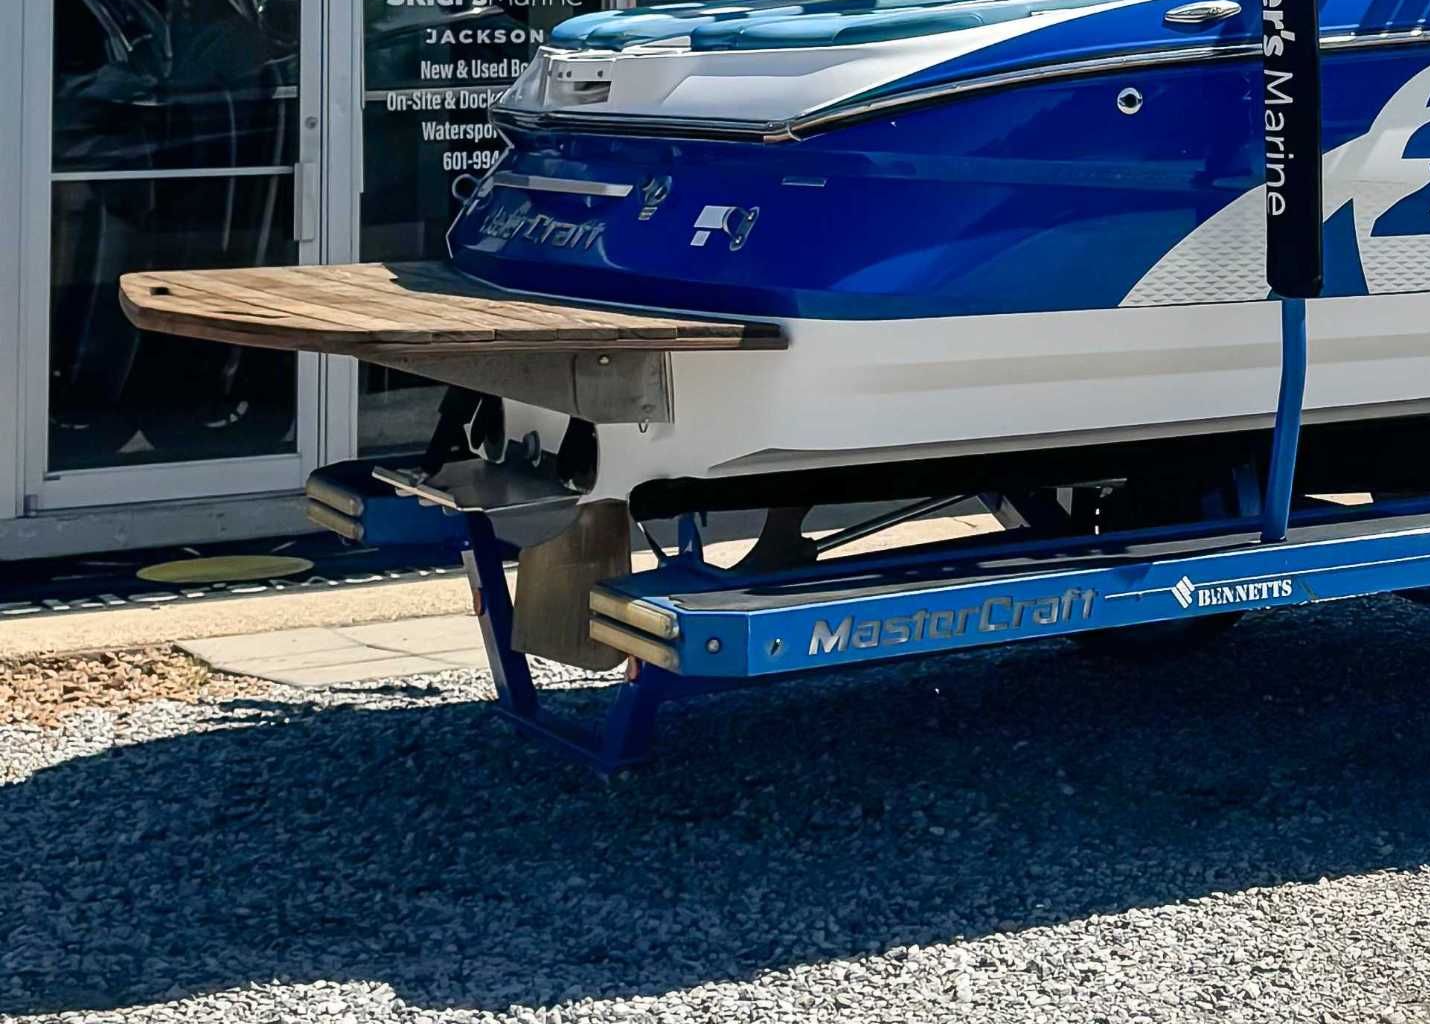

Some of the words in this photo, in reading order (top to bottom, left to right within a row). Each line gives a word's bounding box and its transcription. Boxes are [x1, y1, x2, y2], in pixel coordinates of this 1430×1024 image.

[426, 28, 544, 45] JACKSON
[420, 60, 454, 80] New
[456, 59, 469, 78] &
[471, 58, 507, 78] Used
[386, 91, 442, 111] On-Site
[444, 91, 456, 110] &
[1265, 70, 1295, 216] Marine
[1197, 578, 1293, 608] BENNETTS
[808, 587, 1098, 656] MasterCraft
